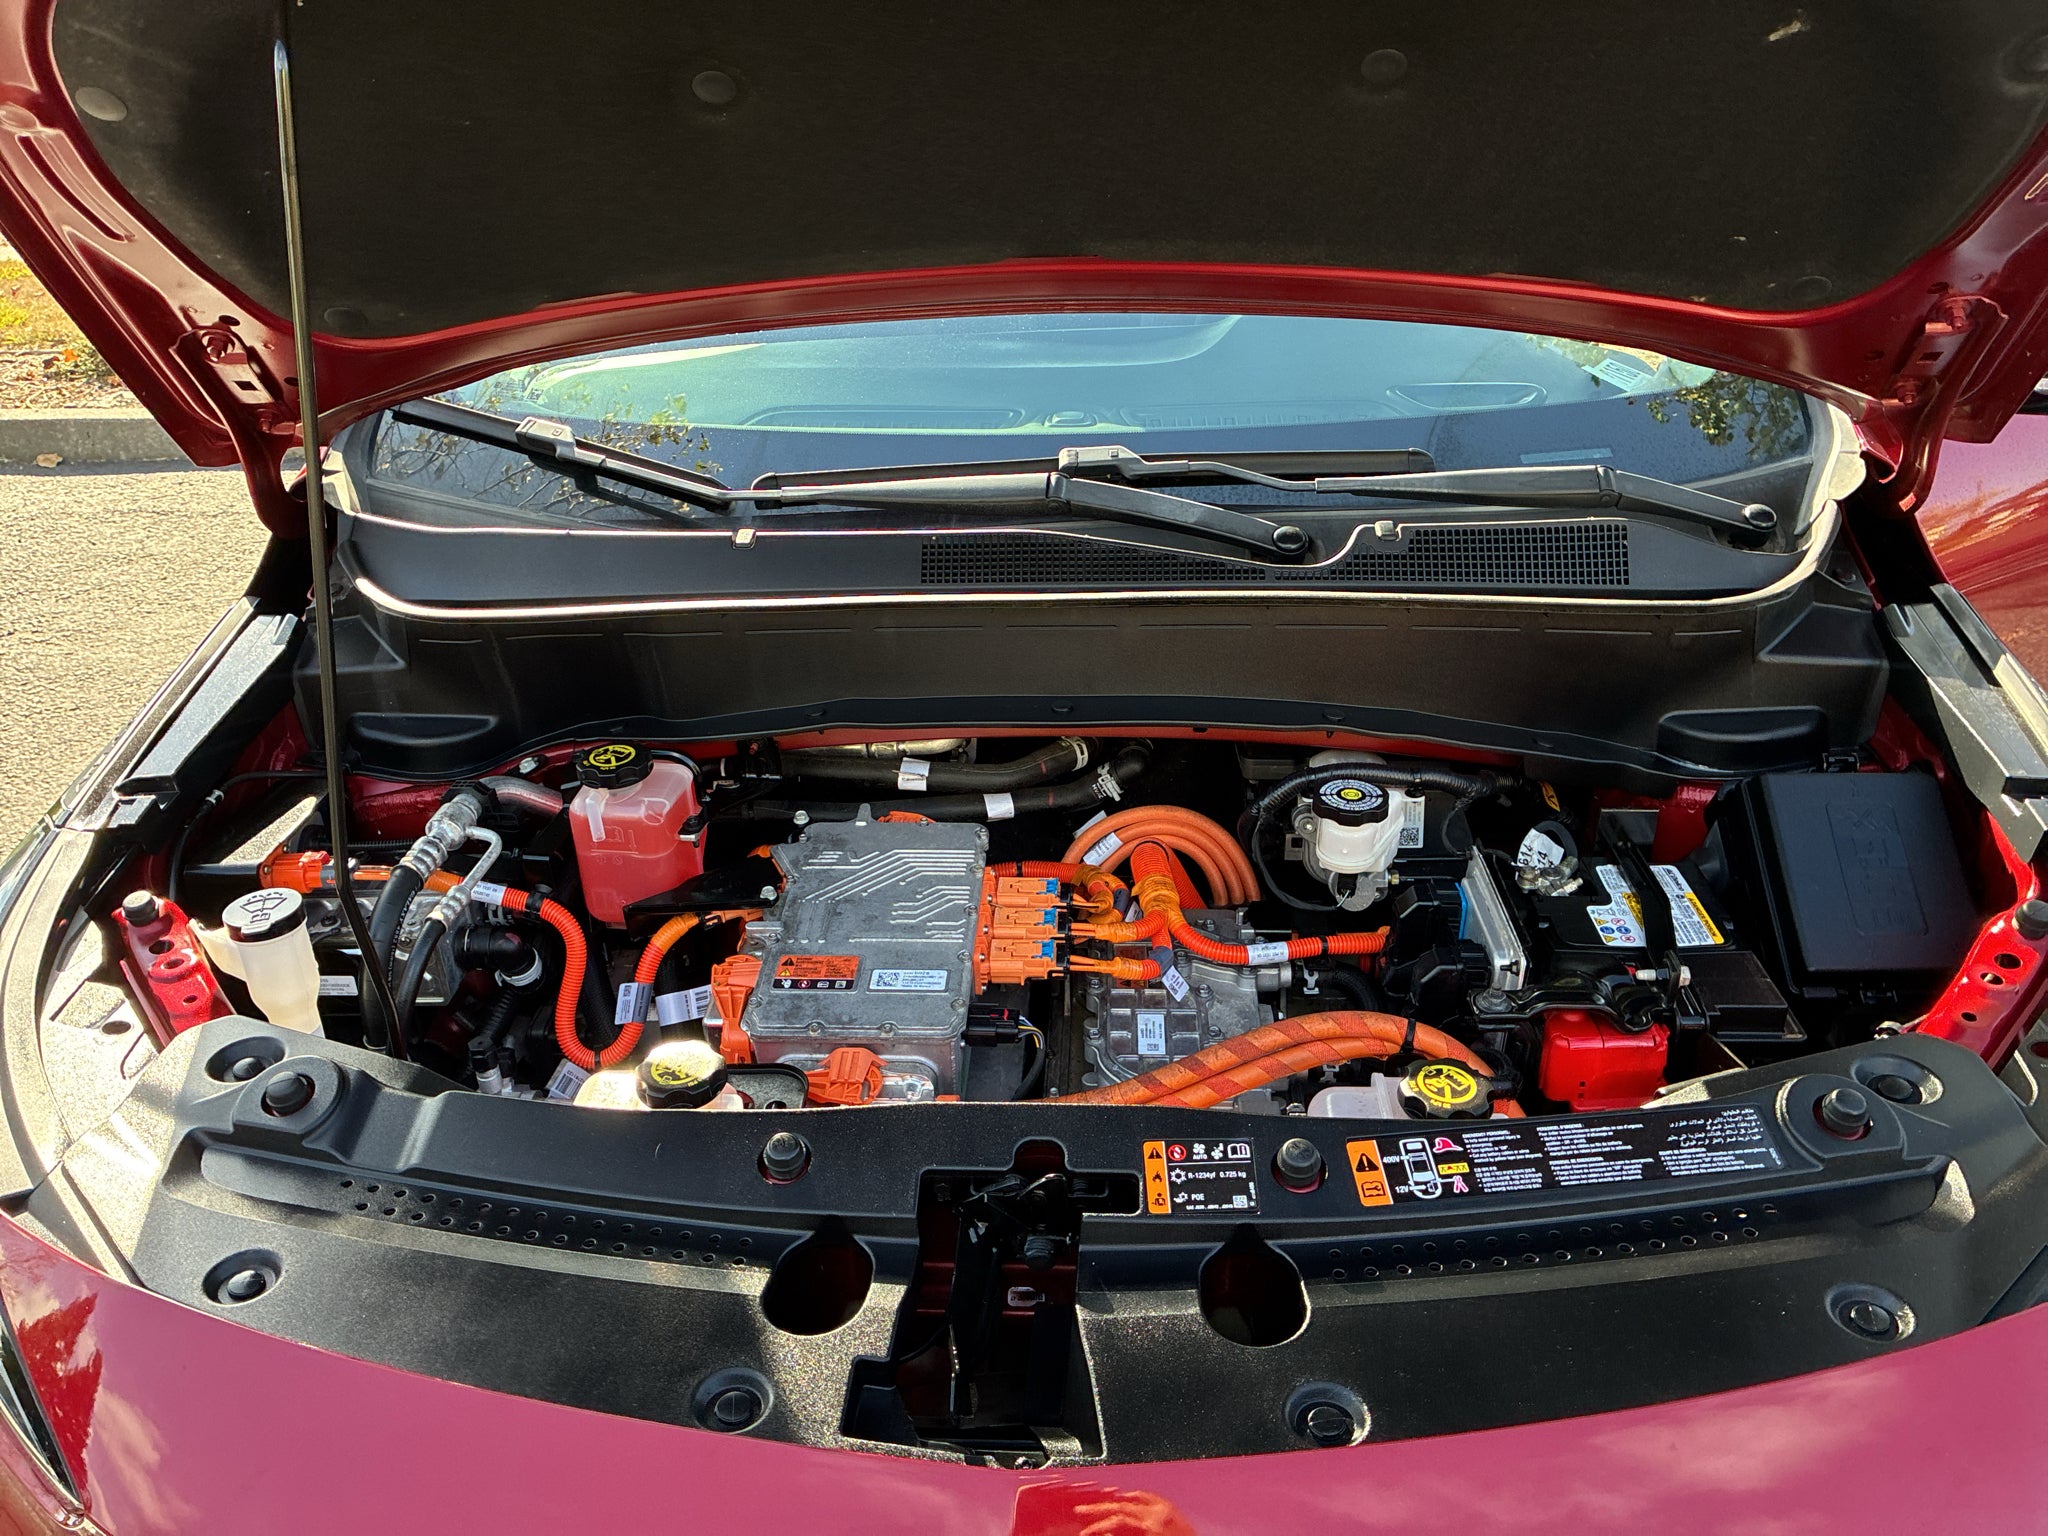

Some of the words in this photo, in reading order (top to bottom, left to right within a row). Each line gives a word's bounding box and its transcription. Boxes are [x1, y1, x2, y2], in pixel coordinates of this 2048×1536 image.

[1382, 1155, 1400, 1164] 400V
[1188, 1171, 1216, 1180] R-1234yf
[1220, 1170, 1237, 1179] 0.725
[1237, 1170, 1247, 1179] kg
[1395, 1185, 1409, 1194] 12V
[1191, 1193, 1205, 1201] POE
